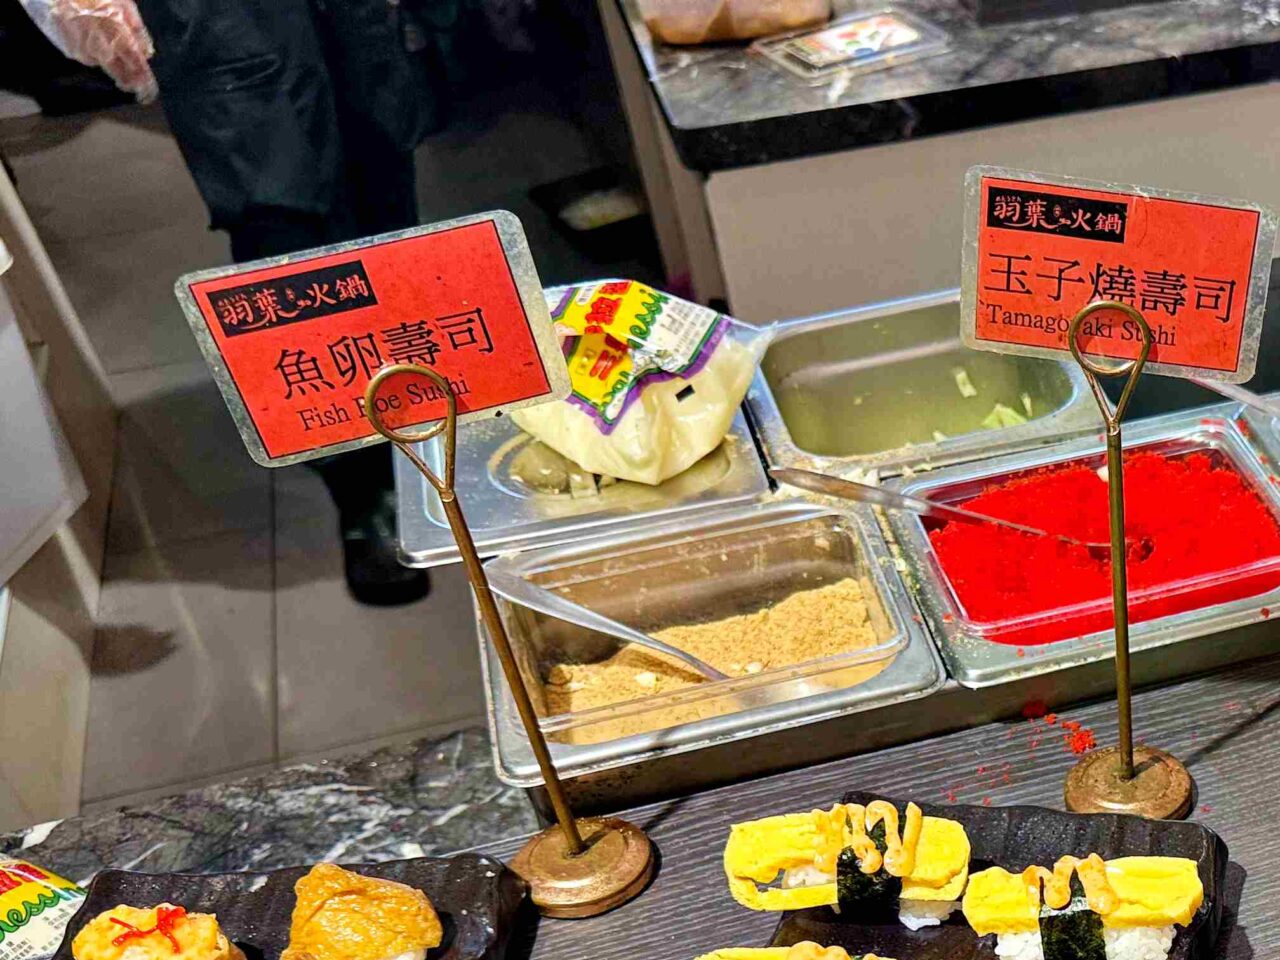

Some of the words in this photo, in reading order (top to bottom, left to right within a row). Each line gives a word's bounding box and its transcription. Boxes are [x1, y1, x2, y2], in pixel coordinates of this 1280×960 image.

[984, 252, 1237, 323] 玉子燒壽司
[986, 304, 1113, 338] Tamagoaki
[274, 308, 495, 400] 魚卵壽司
[296, 404, 351, 432] Fish
